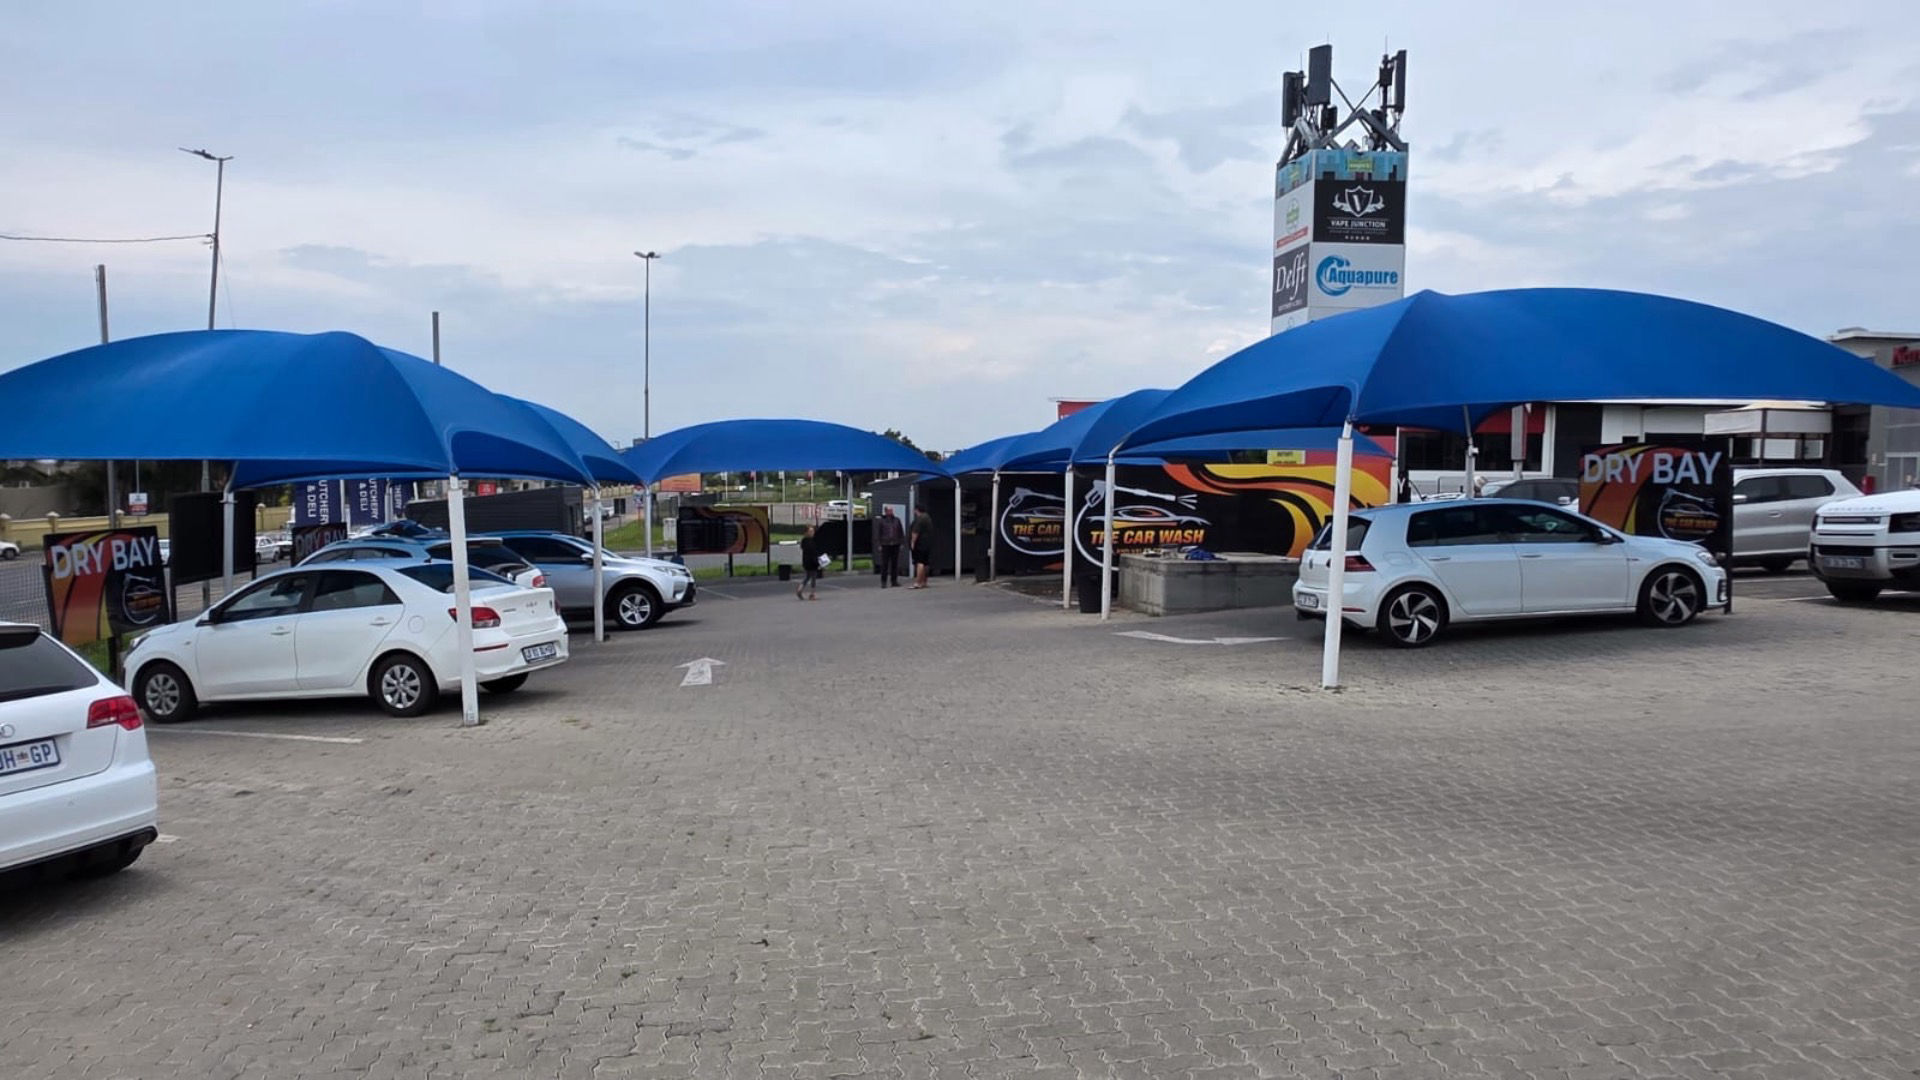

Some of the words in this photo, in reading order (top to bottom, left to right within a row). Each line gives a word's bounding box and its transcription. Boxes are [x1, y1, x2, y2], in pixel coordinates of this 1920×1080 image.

[1350, 220, 1386, 228] JUNCTION
[1275, 252, 1307, 301] Delft
[1328, 266, 1398, 286] Aquapure
[1583, 453, 1644, 483] DRY
[1653, 452, 1722, 484] BAY
[307, 494, 316, 517] DELI
[360, 491, 368, 511] DELI
[1013, 524, 1035, 535] THE
[1038, 524, 1061, 535] CAR
[1123, 530, 1156, 544] CAR
[1158, 529, 1205, 544] WASH
[295, 531, 320, 556] DRY
[51, 541, 104, 579] DRY
[110, 536, 155, 571] BAY
[30, 743, 51, 763] GP
